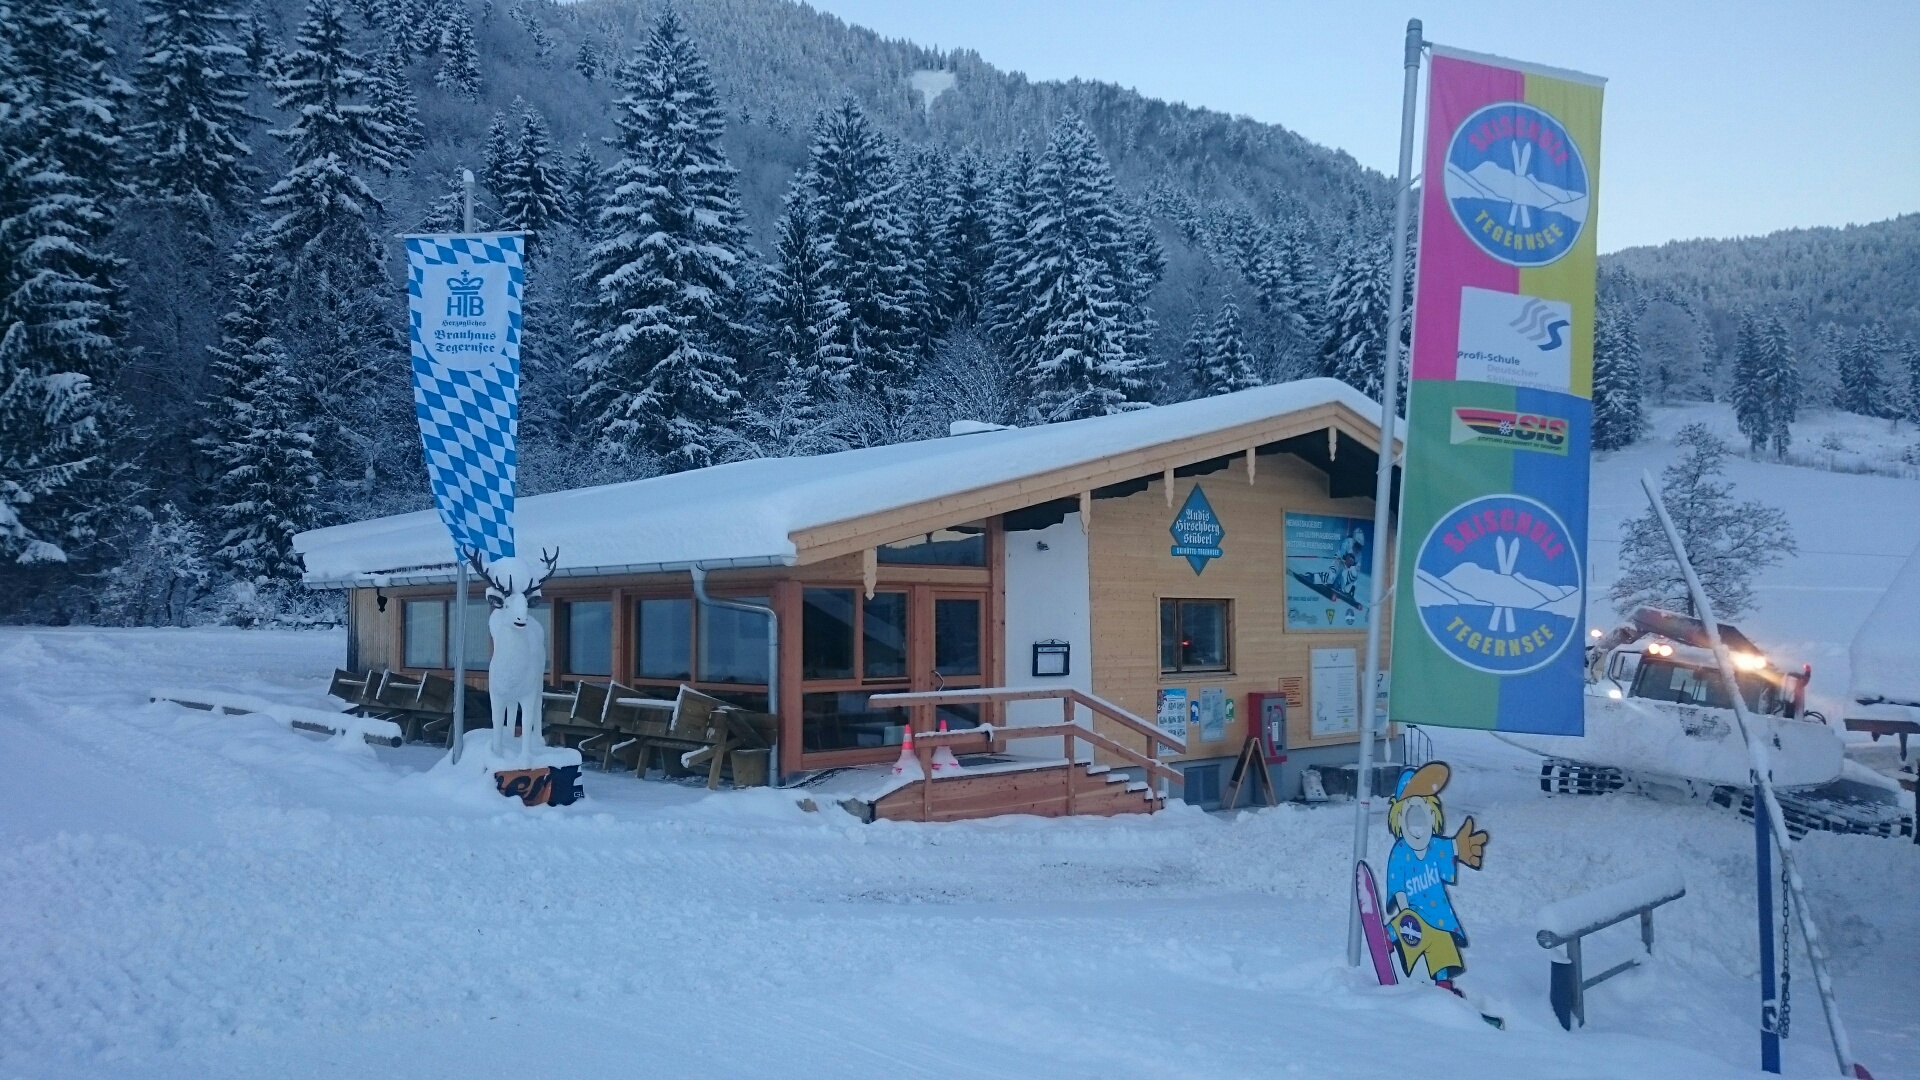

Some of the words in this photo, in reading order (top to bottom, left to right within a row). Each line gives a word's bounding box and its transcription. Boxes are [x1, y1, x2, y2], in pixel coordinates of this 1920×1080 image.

[1469, 115, 1569, 167] SKISCHULE
[1475, 209, 1563, 250] TEGERNSEE
[447, 291, 484, 318] HTB
[434, 330, 496, 341] Brauhaus
[1457, 351, 1520, 365] Profi-Schule
[1487, 364, 1539, 378] Deutscher
[1514, 415, 1566, 444] SIS
[1176, 519, 1219, 536] Hirschberg
[1183, 532, 1212, 544] Stüberl
[1443, 508, 1565, 561] SKISCHULE
[1446, 615, 1554, 657] TEGERNSEE
[1405, 861, 1439, 896] snuki
